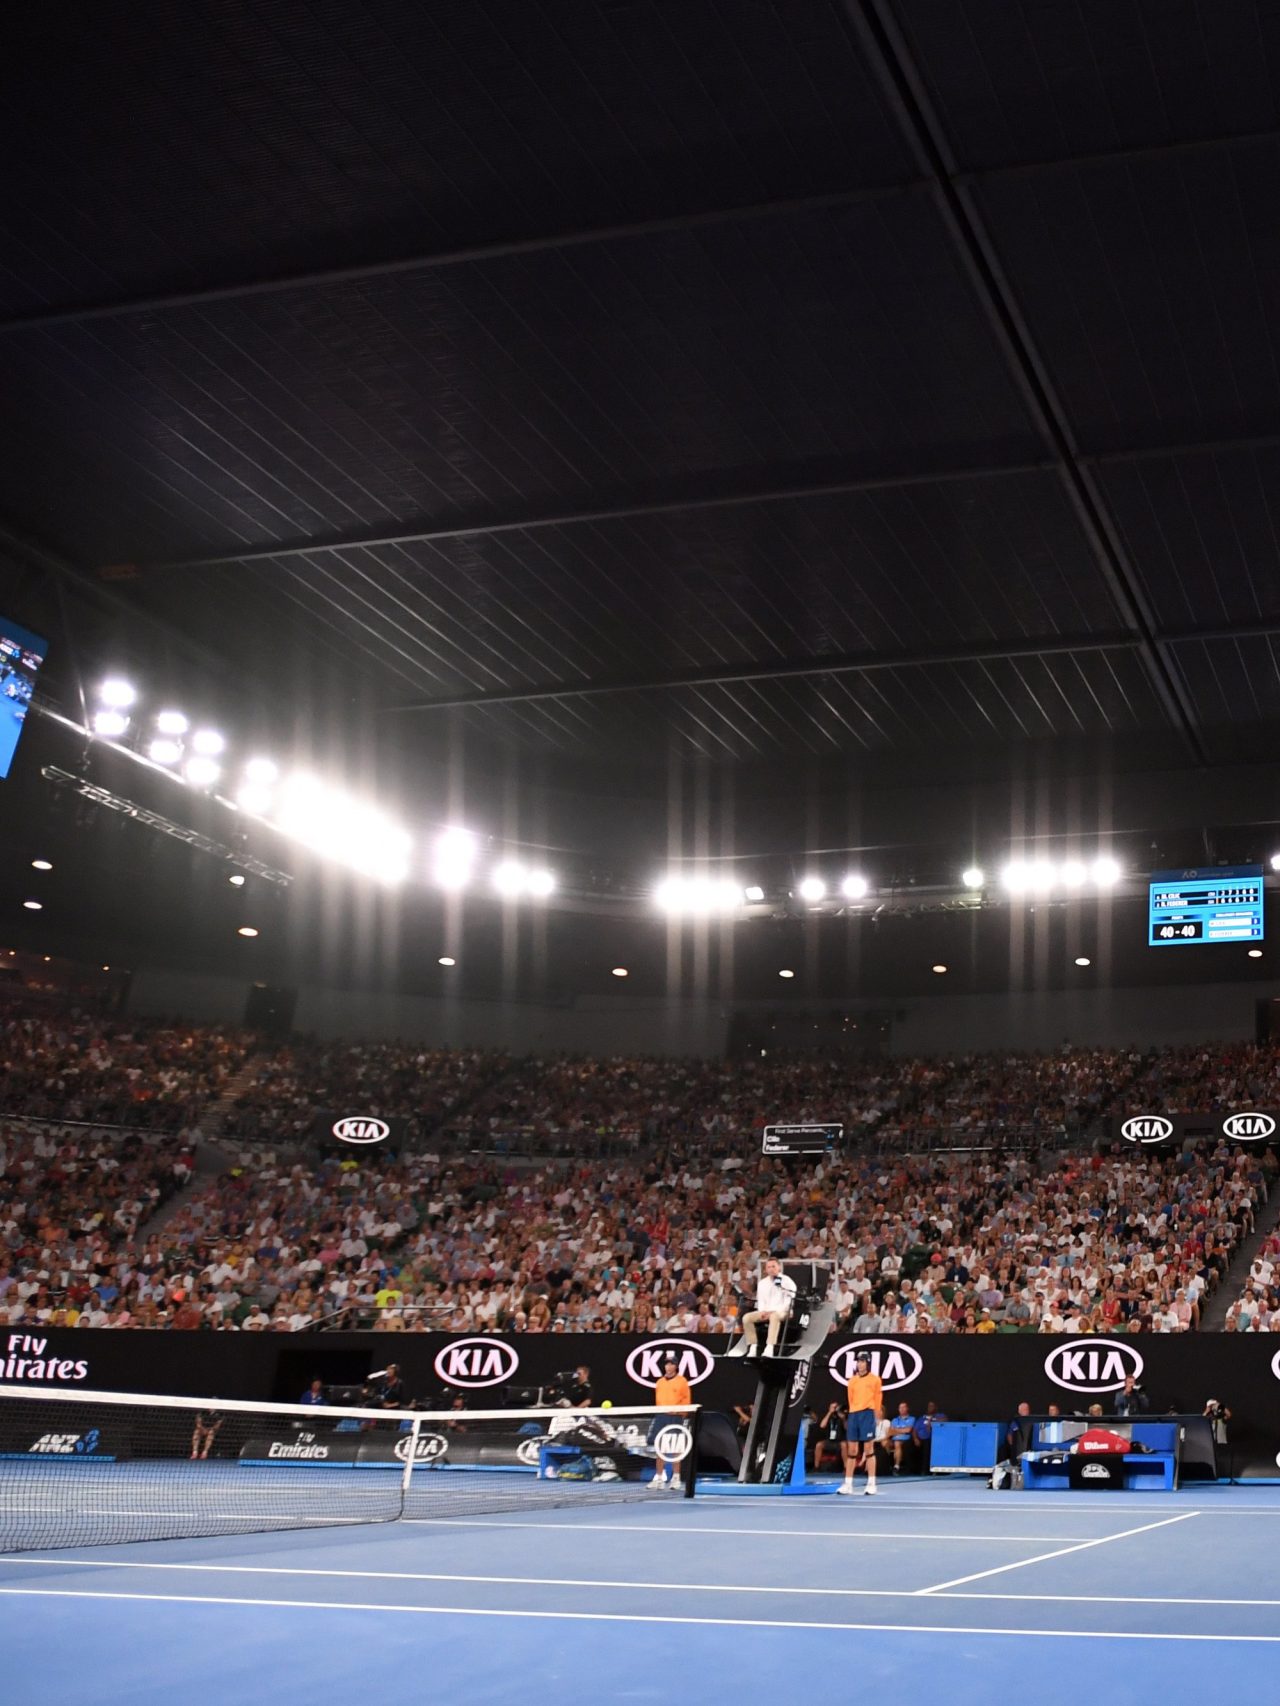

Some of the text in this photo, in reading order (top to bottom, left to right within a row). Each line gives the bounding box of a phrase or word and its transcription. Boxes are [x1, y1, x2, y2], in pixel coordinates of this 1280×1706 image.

[343, 1122, 379, 1138] KIA
[1130, 1121, 1165, 1137] KIA
[1232, 1118, 1267, 1134] KIA
[8, 1335, 48, 1355] Fly
[449, 1349, 504, 1376] KIA
[641, 1350, 698, 1378] KA
[1062, 1351, 1126, 1379] KIA
[268, 1442, 329, 1458] Emirates
[661, 1433, 686, 1454] KIA
